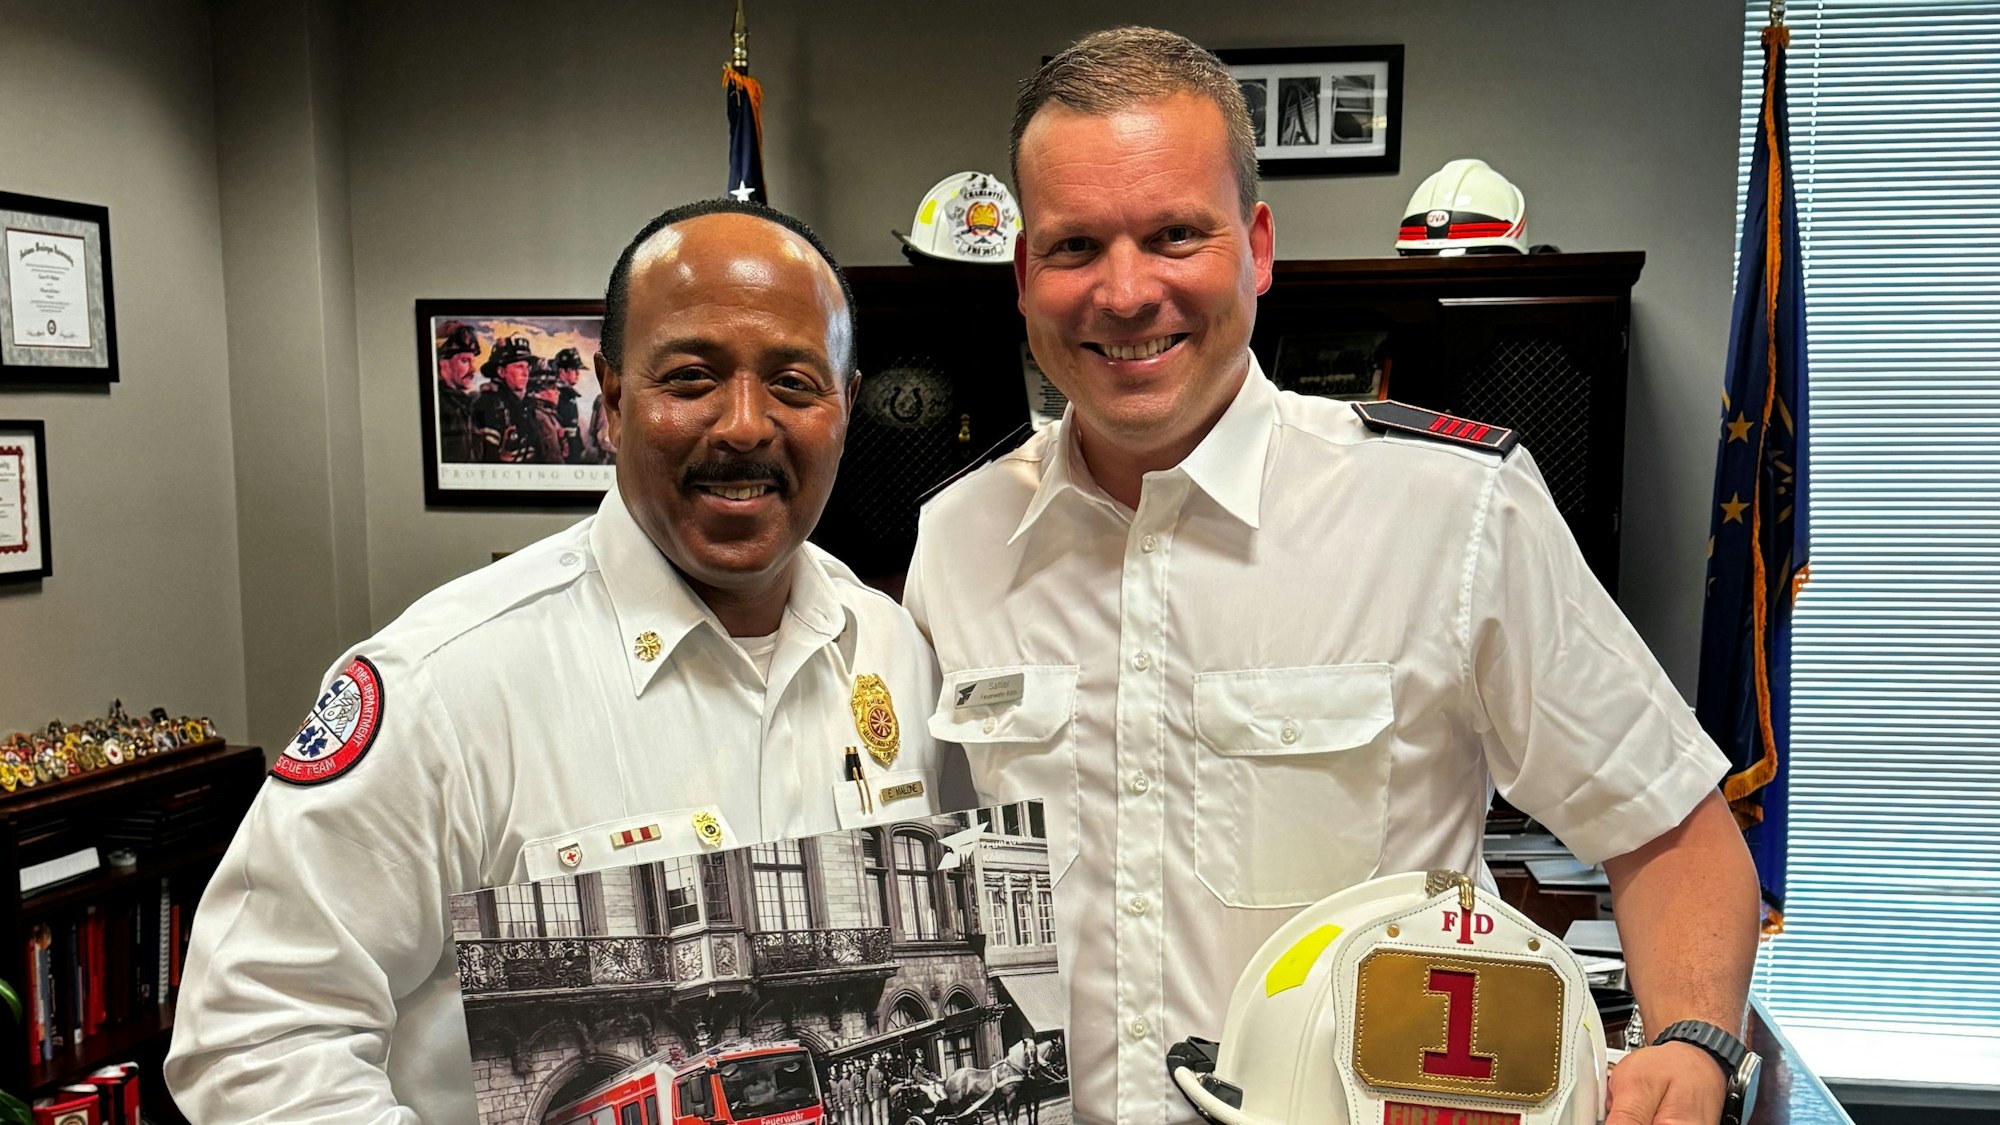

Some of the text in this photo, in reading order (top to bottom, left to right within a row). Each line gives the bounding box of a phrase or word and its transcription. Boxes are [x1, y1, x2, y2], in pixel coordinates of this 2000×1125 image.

[441, 467, 611, 481] PROTECTING OUR
[355, 667, 370, 685] FIRE
[355, 683, 375, 747] DEPARTMENT
[306, 757, 336, 776] TEAM
[1423, 969, 1494, 1079] 1
[761, 1112, 804, 1125] Feuerwehr
[1390, 1104, 1439, 1125] FIRE
